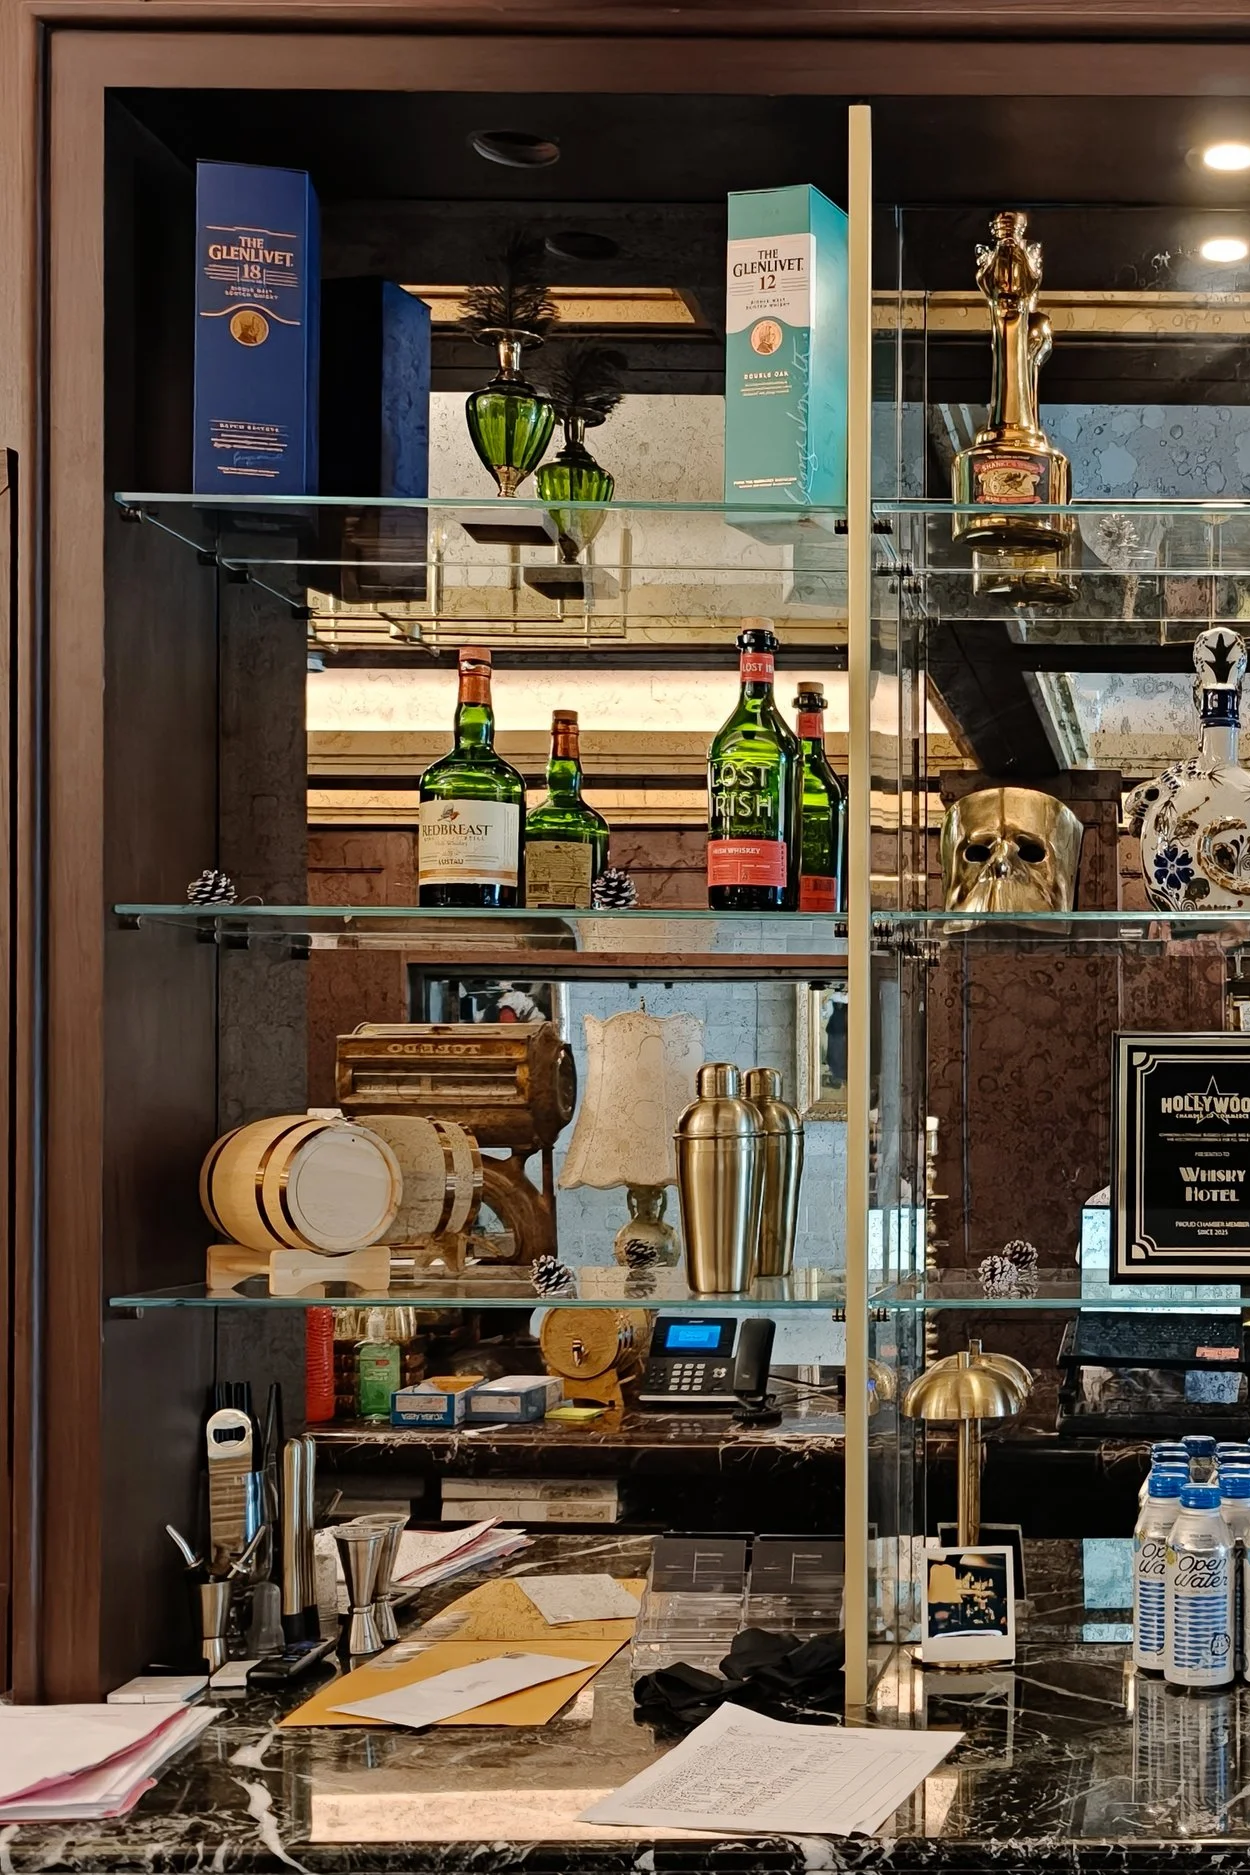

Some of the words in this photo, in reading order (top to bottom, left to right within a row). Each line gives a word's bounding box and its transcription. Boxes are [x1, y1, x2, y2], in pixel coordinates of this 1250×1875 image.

[239, 236, 264, 249] THE
[758, 249, 779, 260] THE
[242, 264, 262, 279] 18
[759, 274, 776, 291] 12
[742, 662, 763, 672] LOST
[711, 762, 771, 788] LOST
[711, 791, 774, 817] IRISH
[422, 823, 494, 837] REDBREAST
[1178, 1555, 1227, 1574] Open
